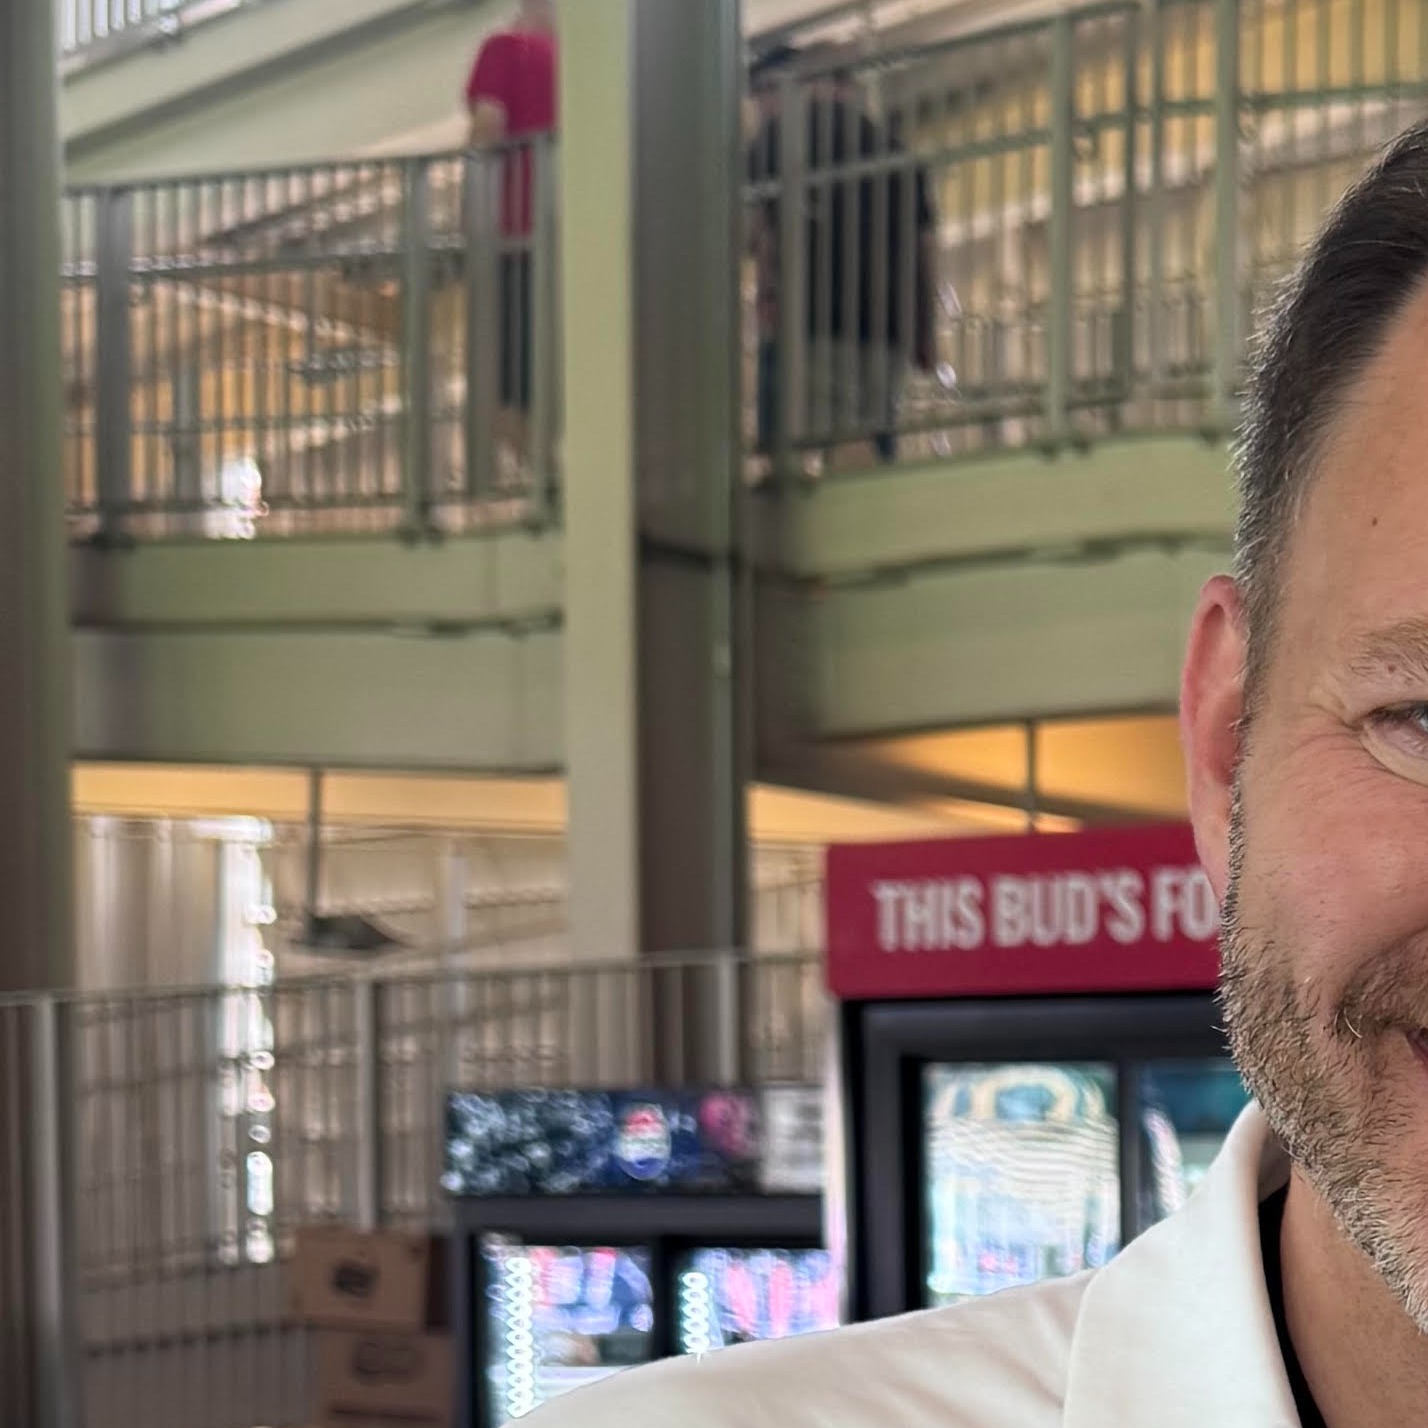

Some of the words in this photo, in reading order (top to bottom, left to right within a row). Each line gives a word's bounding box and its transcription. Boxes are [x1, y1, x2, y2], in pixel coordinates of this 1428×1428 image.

[870, 876, 985, 952] THIS
[989, 867, 1147, 948] BUD'S
[1150, 866, 1222, 942] FO
